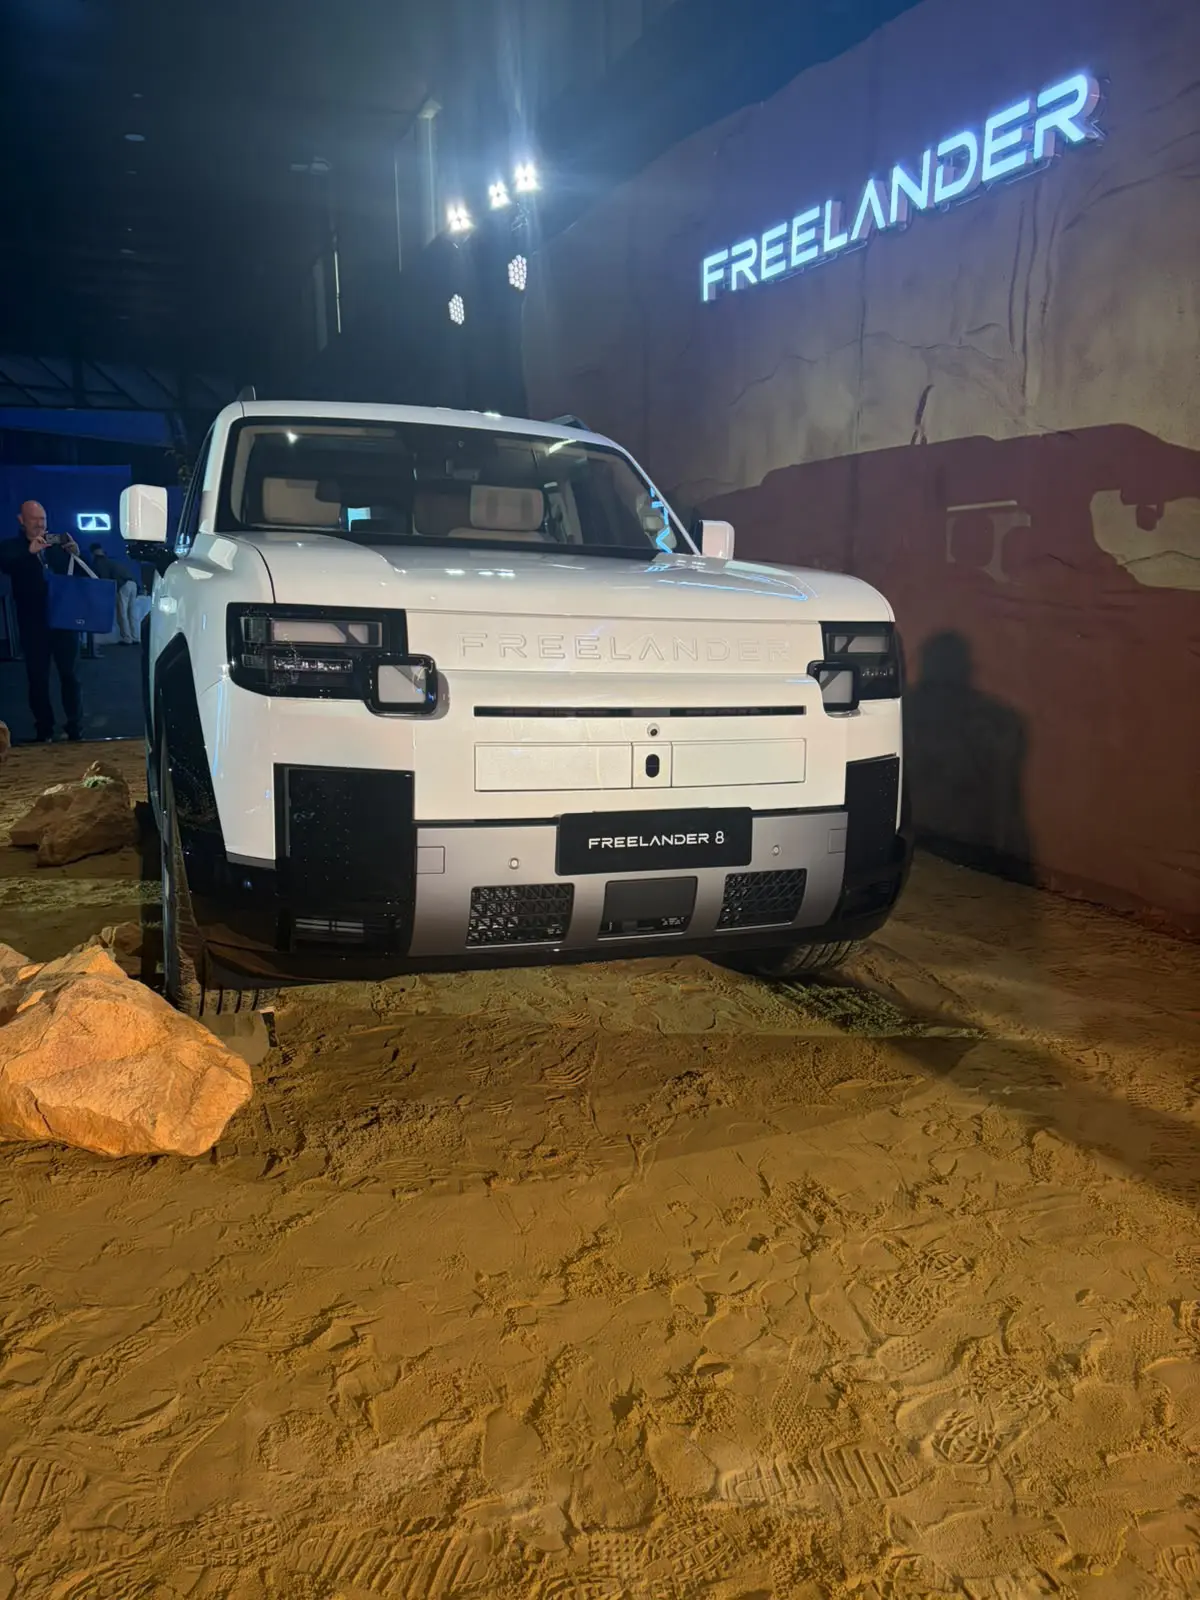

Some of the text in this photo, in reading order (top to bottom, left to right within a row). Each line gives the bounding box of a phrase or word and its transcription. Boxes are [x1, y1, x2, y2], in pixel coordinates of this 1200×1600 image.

[702, 73, 1089, 302] FREELANDER
[459, 633, 790, 662] FREELANDER
[588, 831, 725, 850] FREELANDER 8
